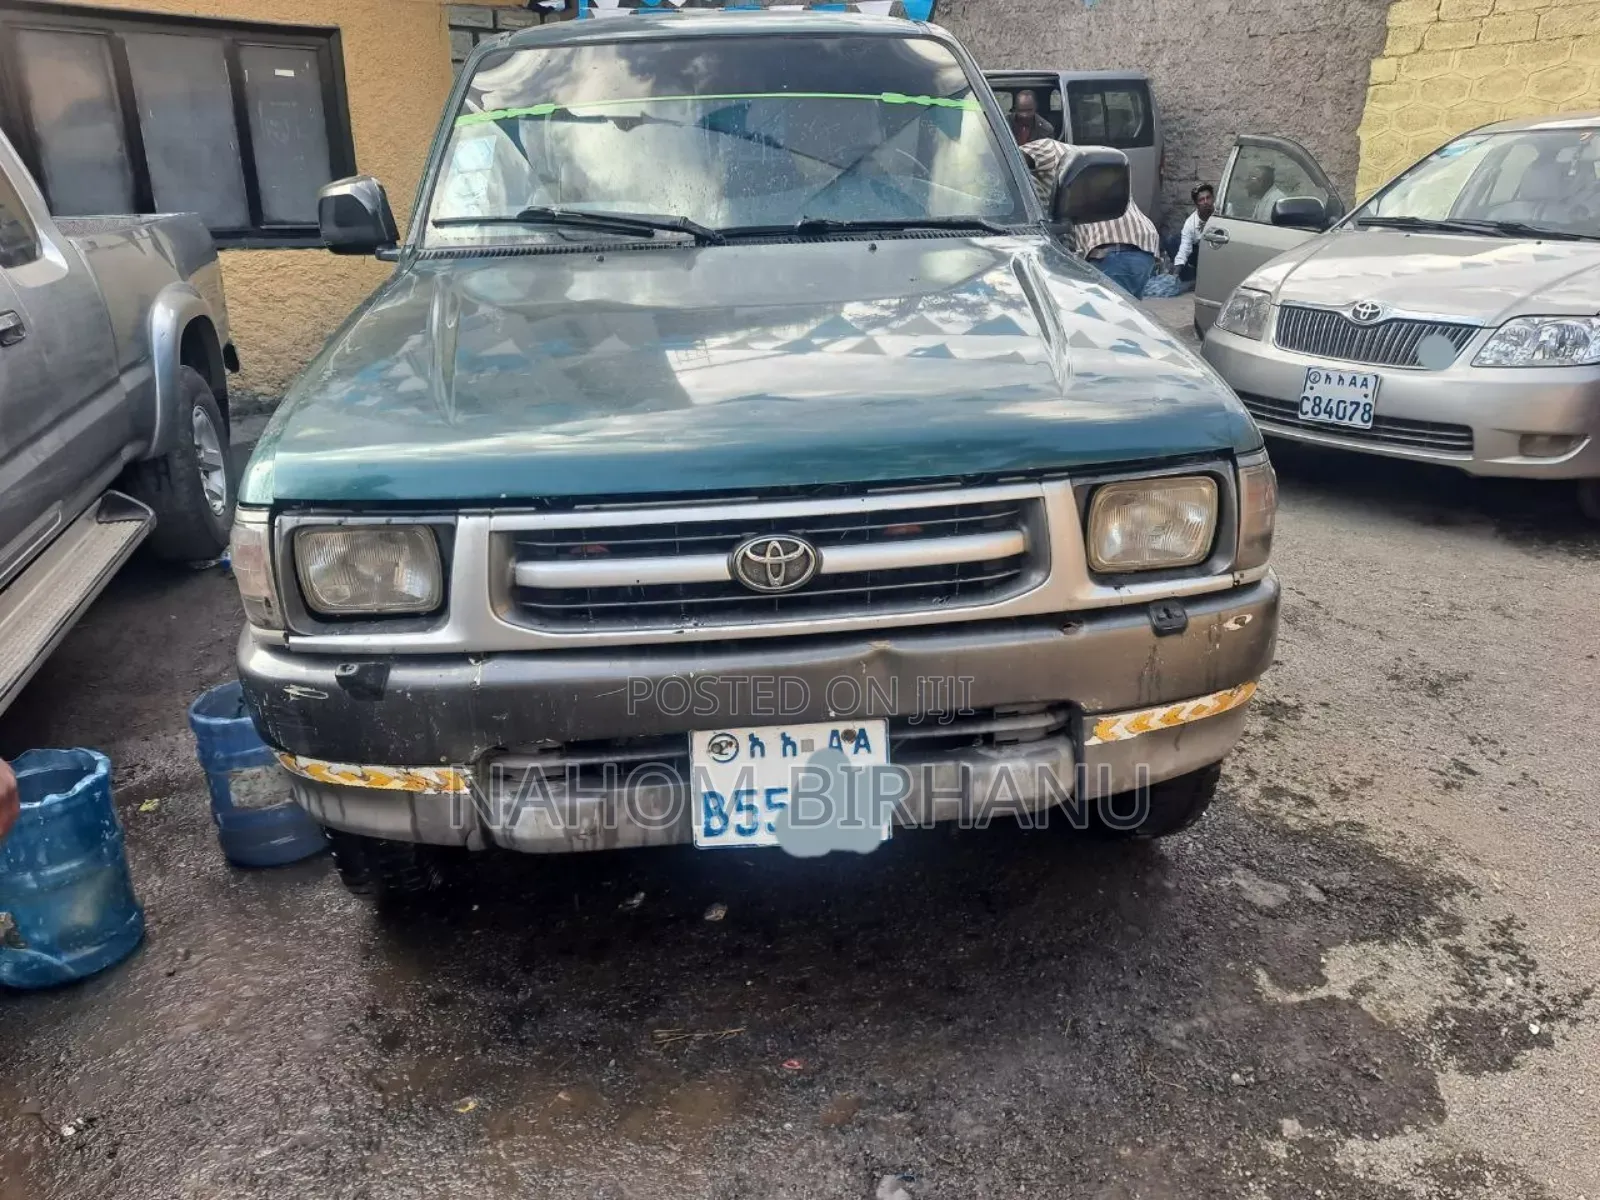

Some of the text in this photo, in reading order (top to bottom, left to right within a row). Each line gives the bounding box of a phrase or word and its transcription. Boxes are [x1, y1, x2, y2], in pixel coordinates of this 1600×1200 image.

[1348, 375, 1369, 389] AA
[1300, 395, 1373, 423] C84078
[828, 728, 872, 755] AA
